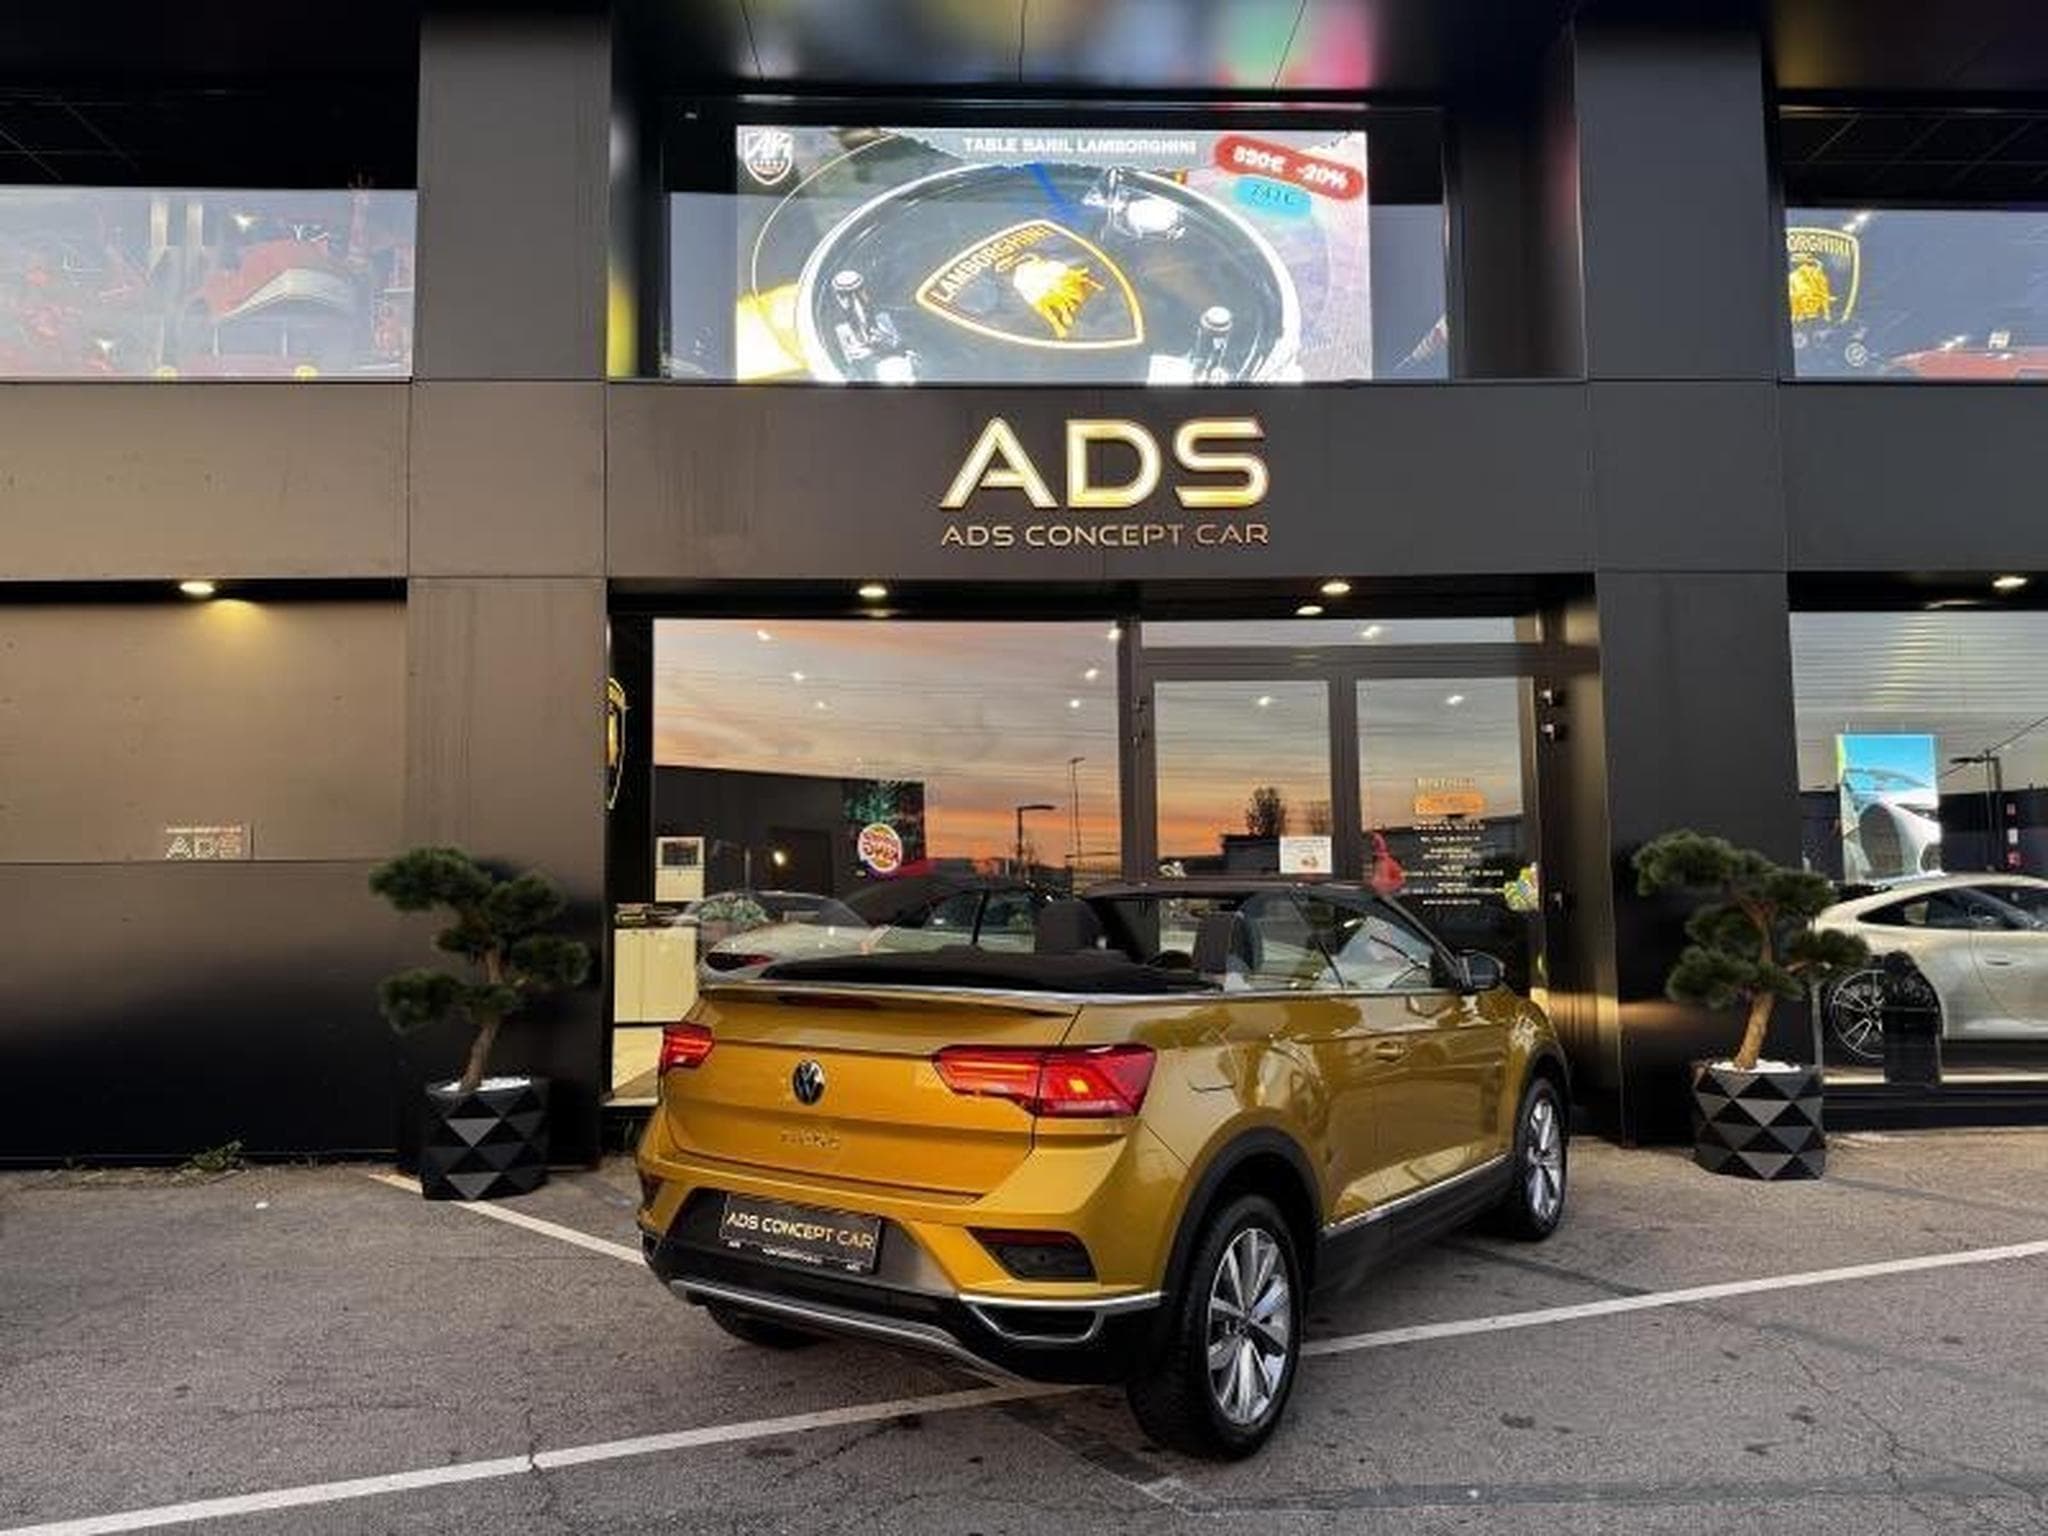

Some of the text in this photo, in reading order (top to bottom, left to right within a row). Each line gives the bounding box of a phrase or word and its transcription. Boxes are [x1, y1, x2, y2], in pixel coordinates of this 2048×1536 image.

[962, 137, 1017, 153] TABLE
[1077, 138, 1197, 155] LAMBORGHINI
[929, 224, 1054, 303] LAMBORGHINI
[939, 416, 1270, 509] ADS
[940, 523, 1269, 547] ADS CONCEPT CAR
[726, 1211, 875, 1249] ADS CONCEPT CAR
